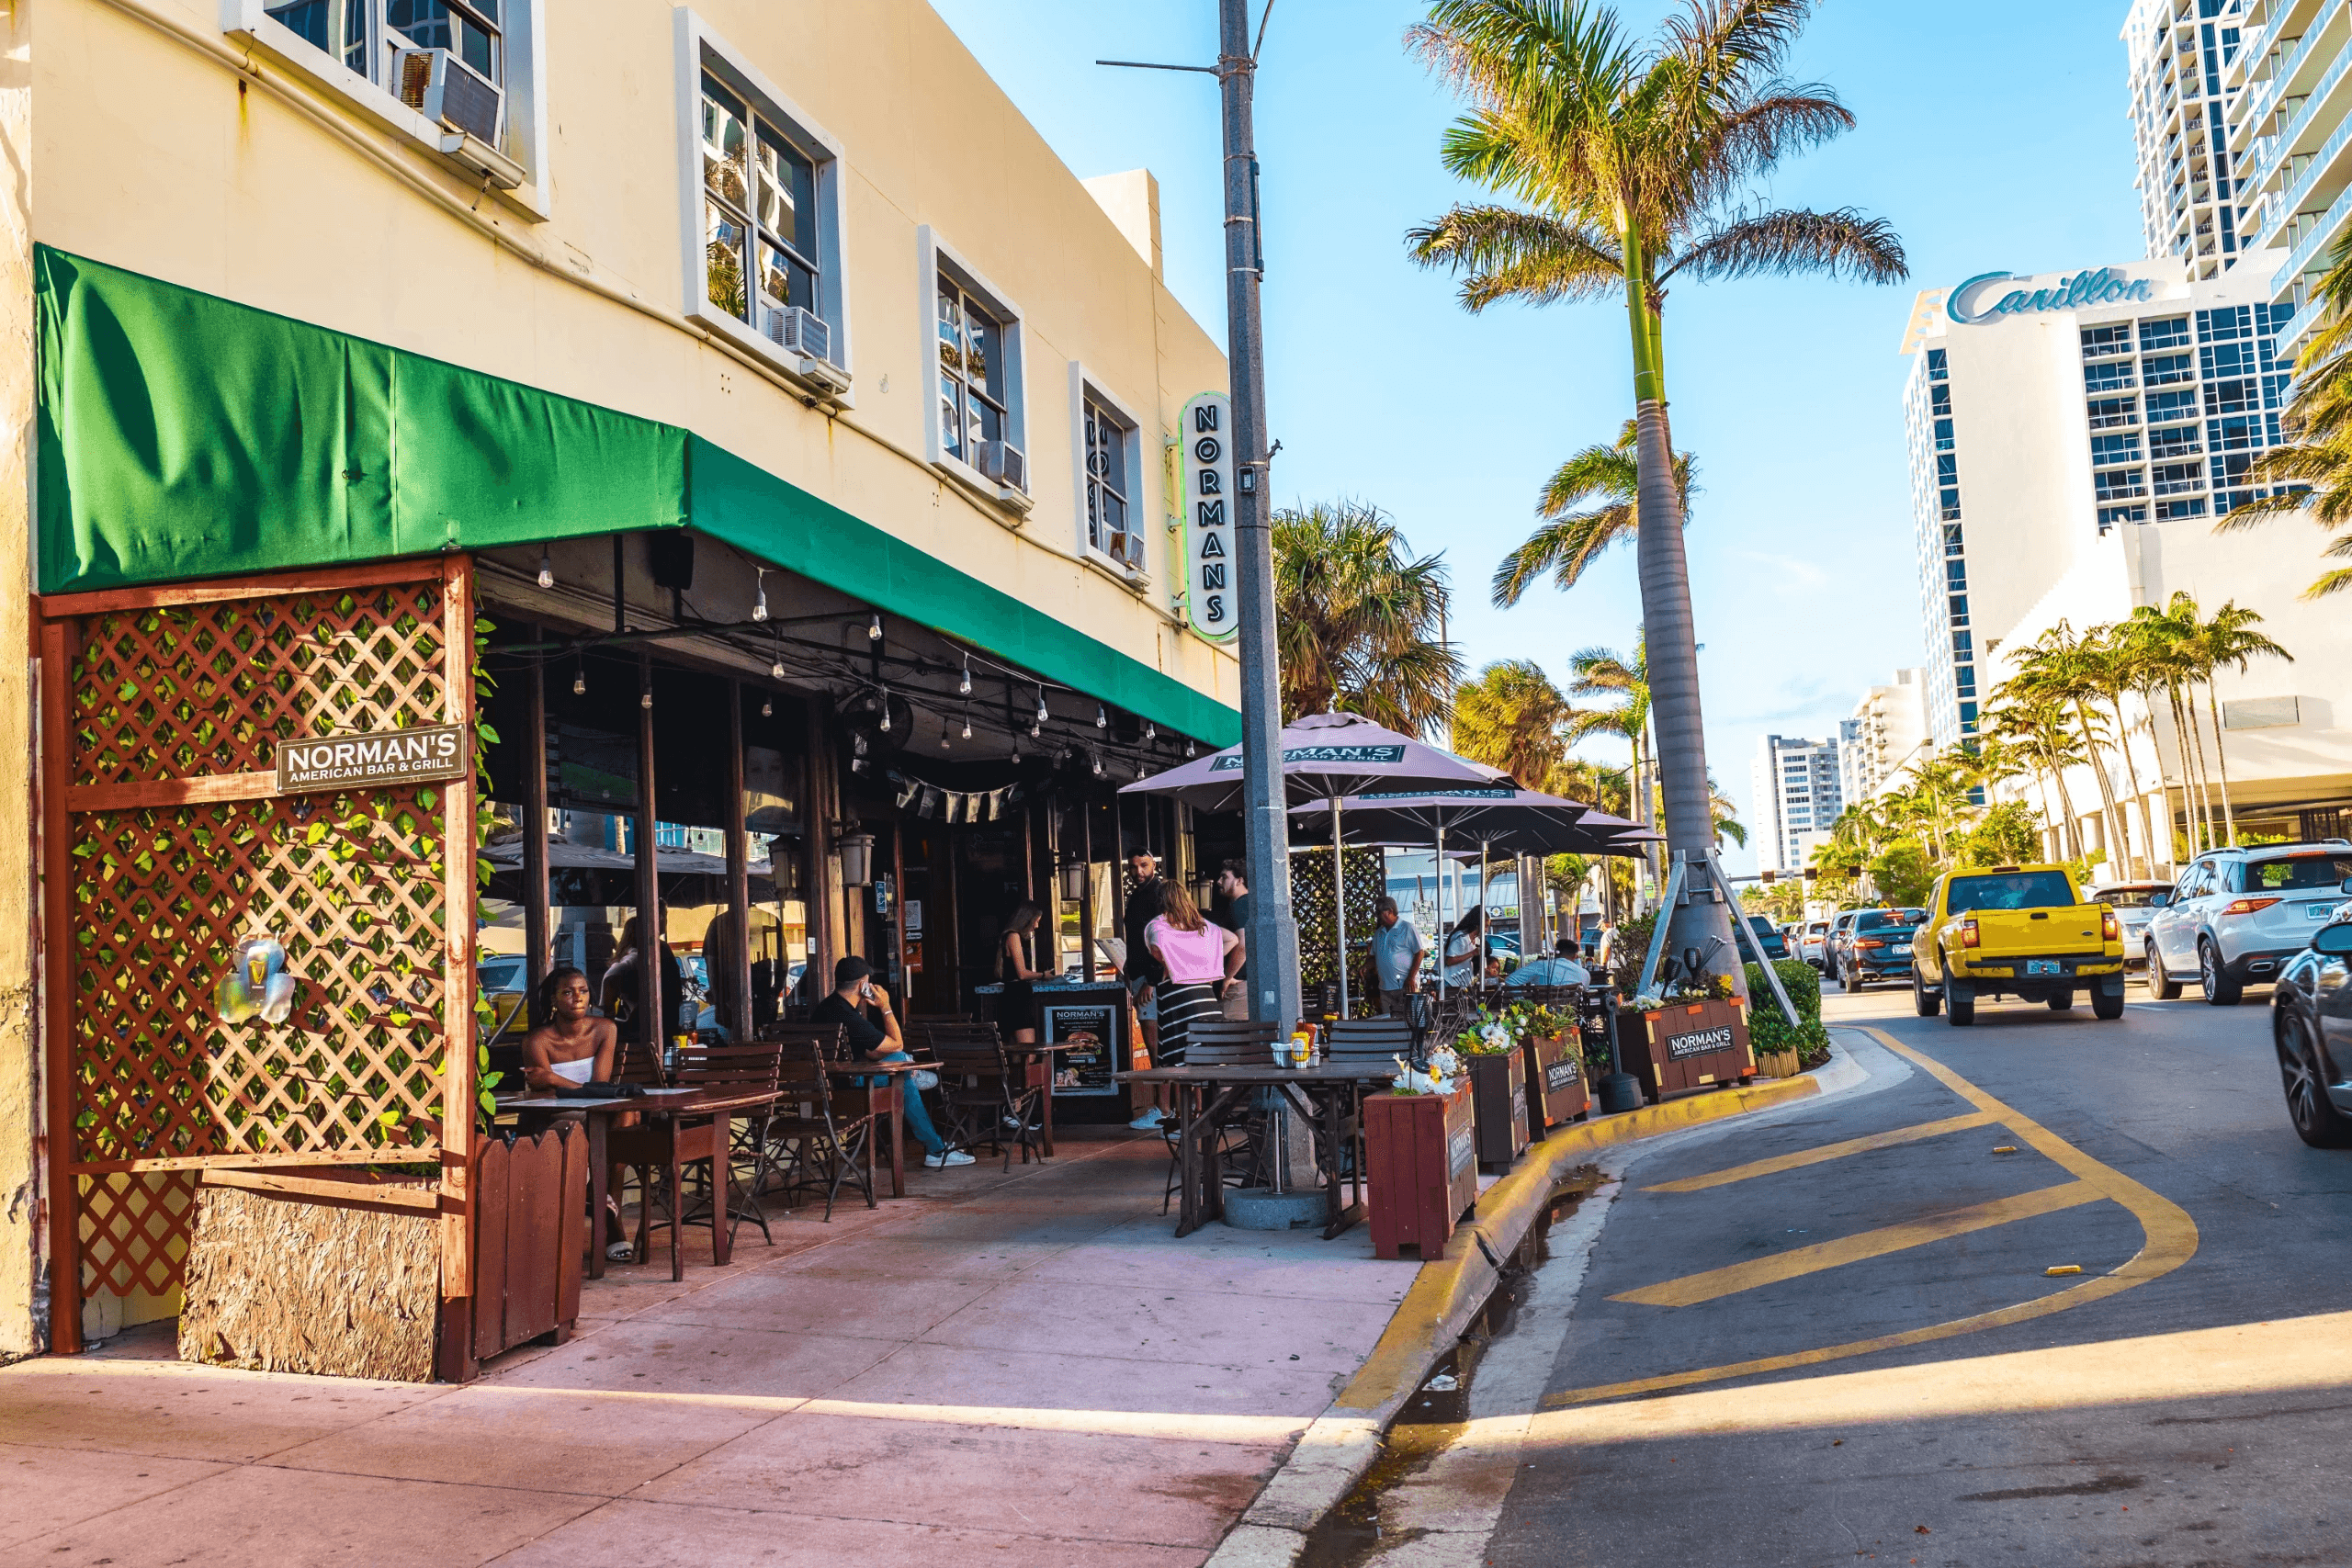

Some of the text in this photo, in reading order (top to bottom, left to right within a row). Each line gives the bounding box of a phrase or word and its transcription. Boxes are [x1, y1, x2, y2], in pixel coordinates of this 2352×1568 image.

[1946, 267, 2153, 323] Carillon
[1194, 405, 1226, 622] NORMANS
[288, 733, 457, 772] NORMAN'S
[1224, 747, 1393, 766] NMAN'S
[289, 758, 454, 783] AMERICAN BAR & GRILL
[1671, 1029, 1731, 1051] NORMAN'S
[1674, 1046, 1701, 1055] AMERICAN
[1548, 1062, 1577, 1082] NORMAN'S
